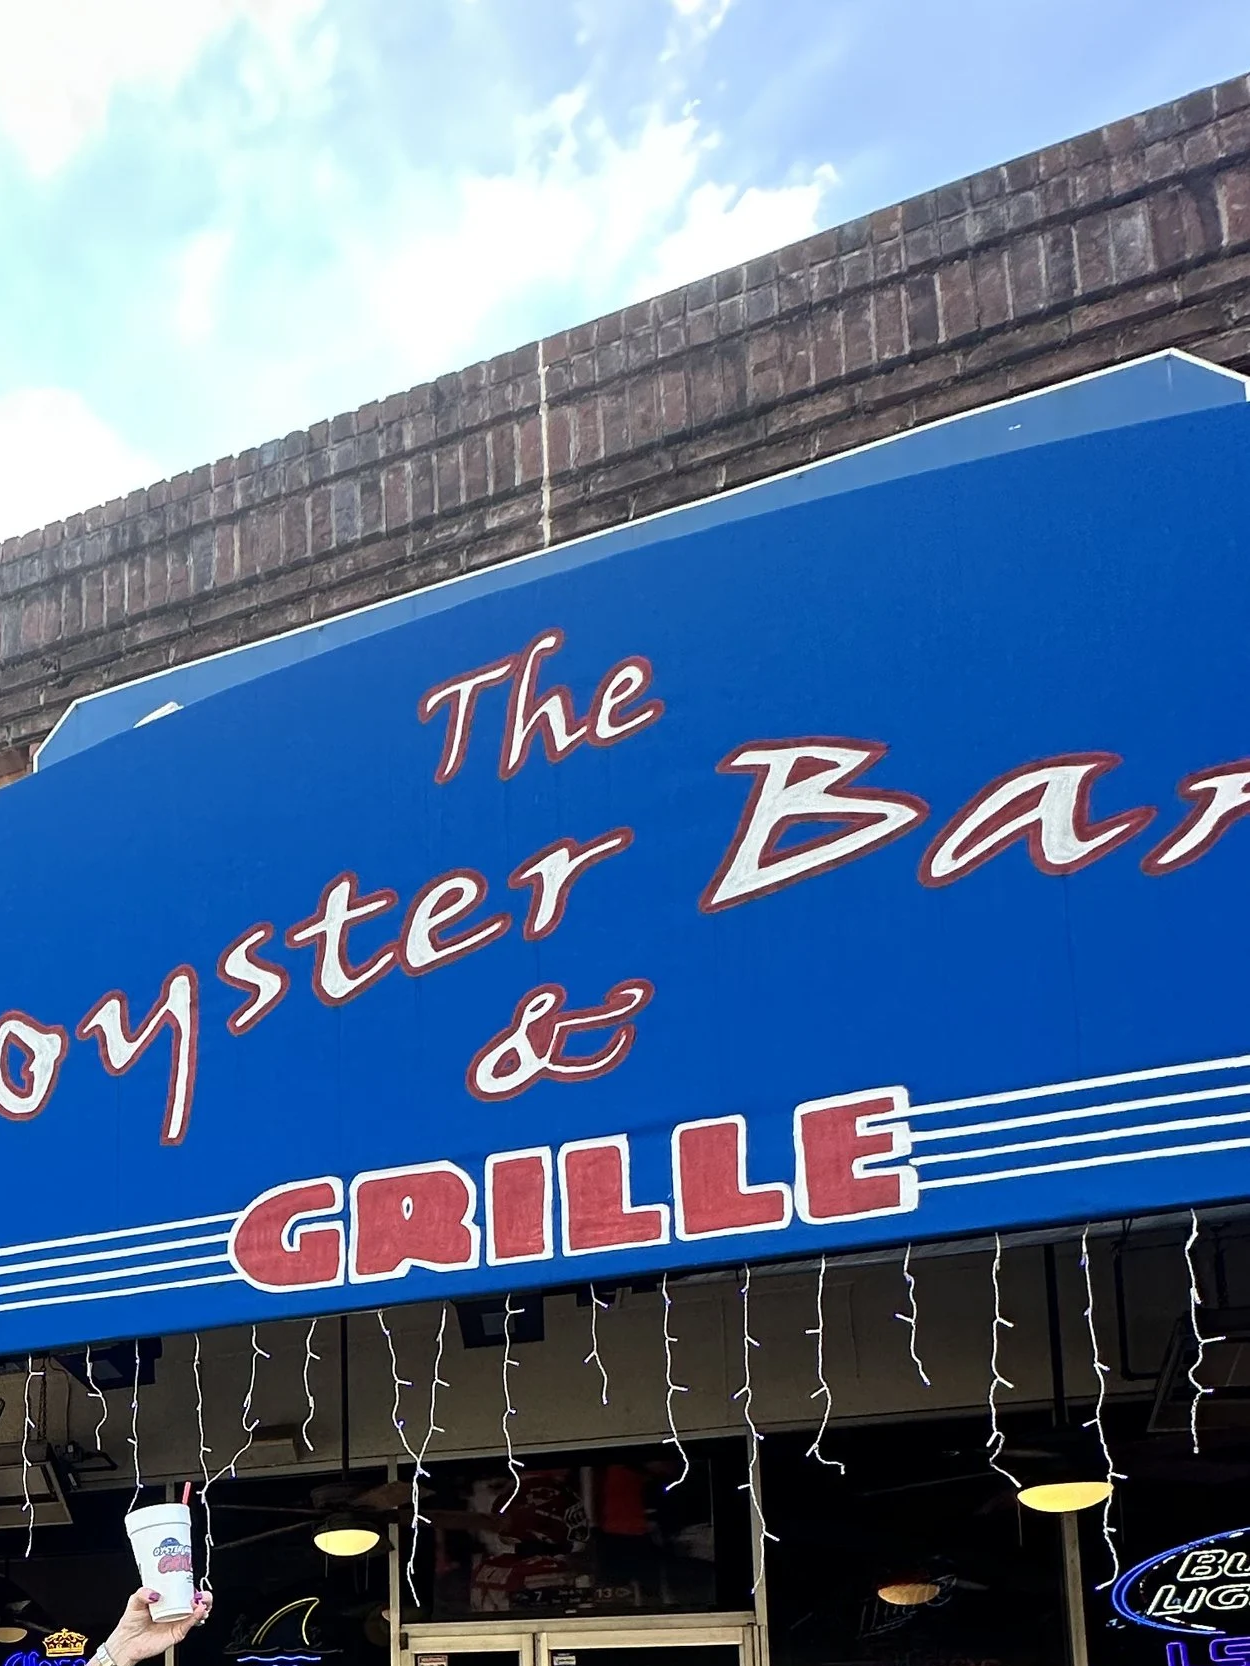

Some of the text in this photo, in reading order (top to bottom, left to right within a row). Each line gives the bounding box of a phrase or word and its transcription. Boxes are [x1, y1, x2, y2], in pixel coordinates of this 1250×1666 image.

[418, 628, 665, 783] The
[699, 736, 1250, 913] Bar
[467, 978, 655, 1101] &
[226, 1085, 920, 1294] GRILLE
